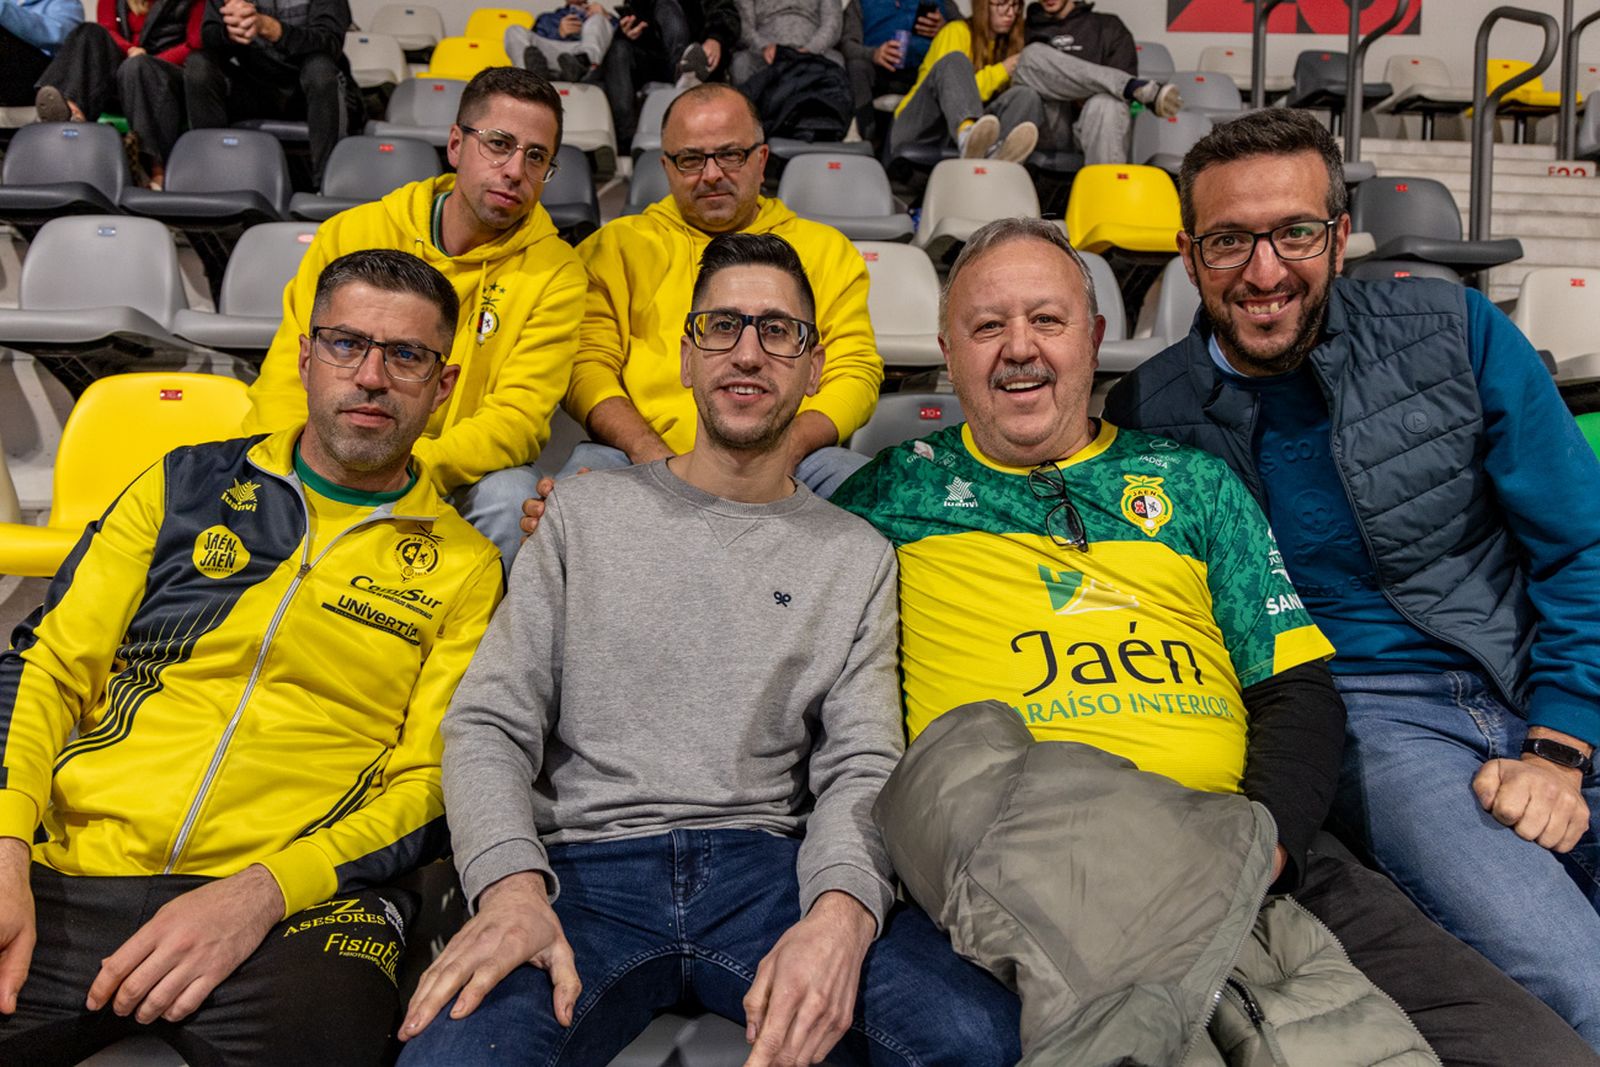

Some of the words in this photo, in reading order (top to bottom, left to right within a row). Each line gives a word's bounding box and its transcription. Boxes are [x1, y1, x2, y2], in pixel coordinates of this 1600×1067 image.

[1010, 621, 1204, 698] Jaén
[1130, 692, 1234, 719] INTERIOR
[283, 913, 387, 938] ASESORES
